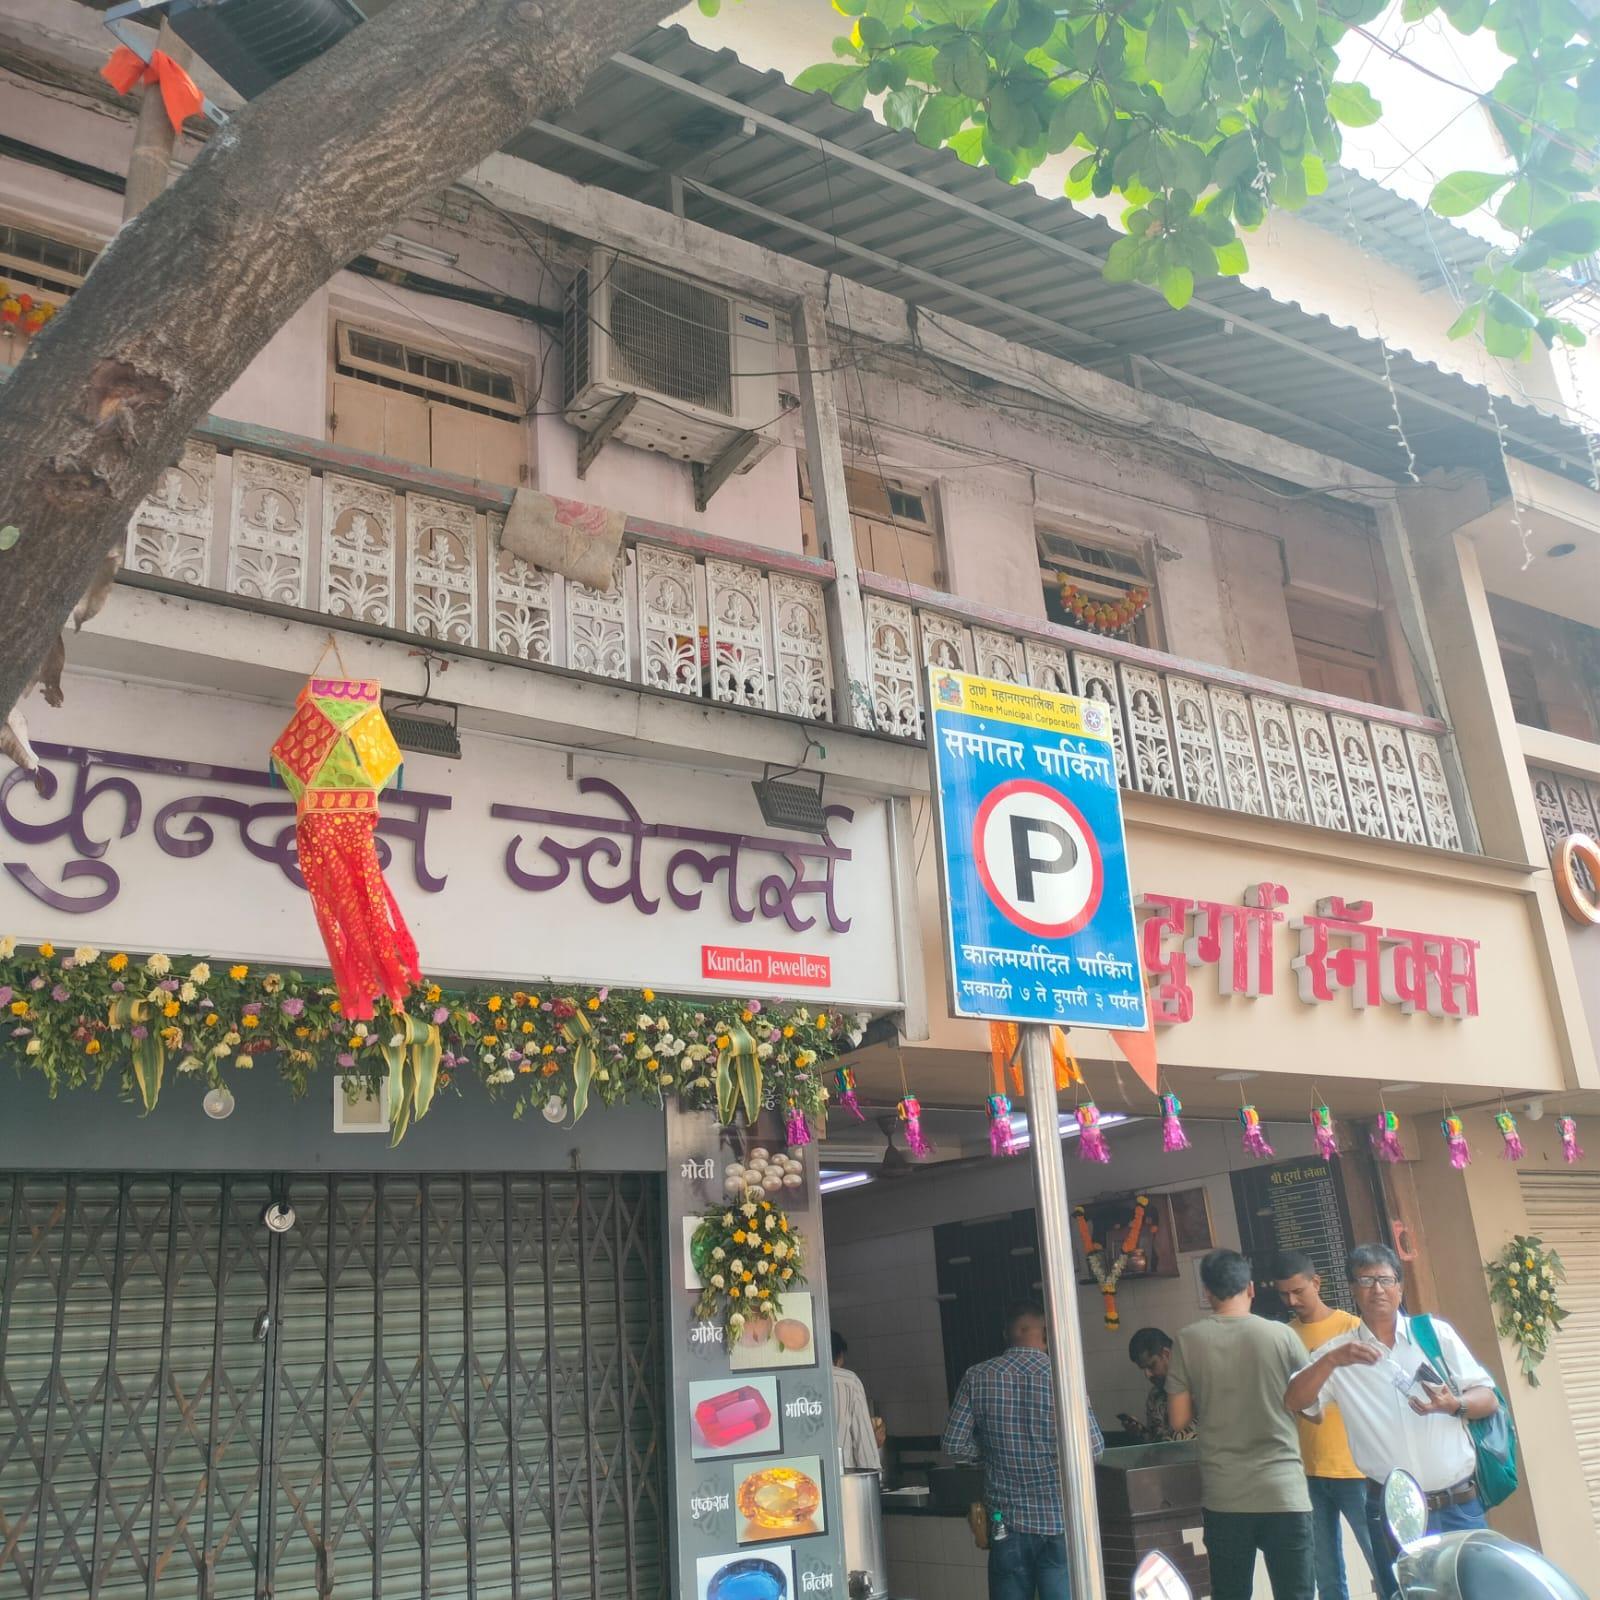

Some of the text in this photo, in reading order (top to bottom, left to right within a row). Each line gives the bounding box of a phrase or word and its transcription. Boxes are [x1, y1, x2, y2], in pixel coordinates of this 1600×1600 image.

[969, 682, 987, 699] ठाणे
[1059, 702, 1077, 717] ठाणे
[970, 700, 1081, 731] Thane Municipal Corporation
[940, 722, 1111, 784] समांतर पार्किंग
[1009, 814, 1079, 904] P
[706, 950, 827, 980] Kundan Jewellers
[960, 943, 1134, 982] कालमर्यादित पार्किंग
[1139, 882, 1290, 1025] दुर्गा
[961, 977, 1013, 1000] सकाळी
[1019, 986, 1031, 1001] ७
[1035, 981, 1047, 1003] ते
[1052, 984, 1088, 1013] दुपारी
[1095, 993, 1104, 1012] ३
[680, 1158, 714, 1180] मोती
[690, 1320, 724, 1344] गोमेद
[785, 1396, 823, 1418] माणिक
[801, 1570, 833, 1593] निलम
